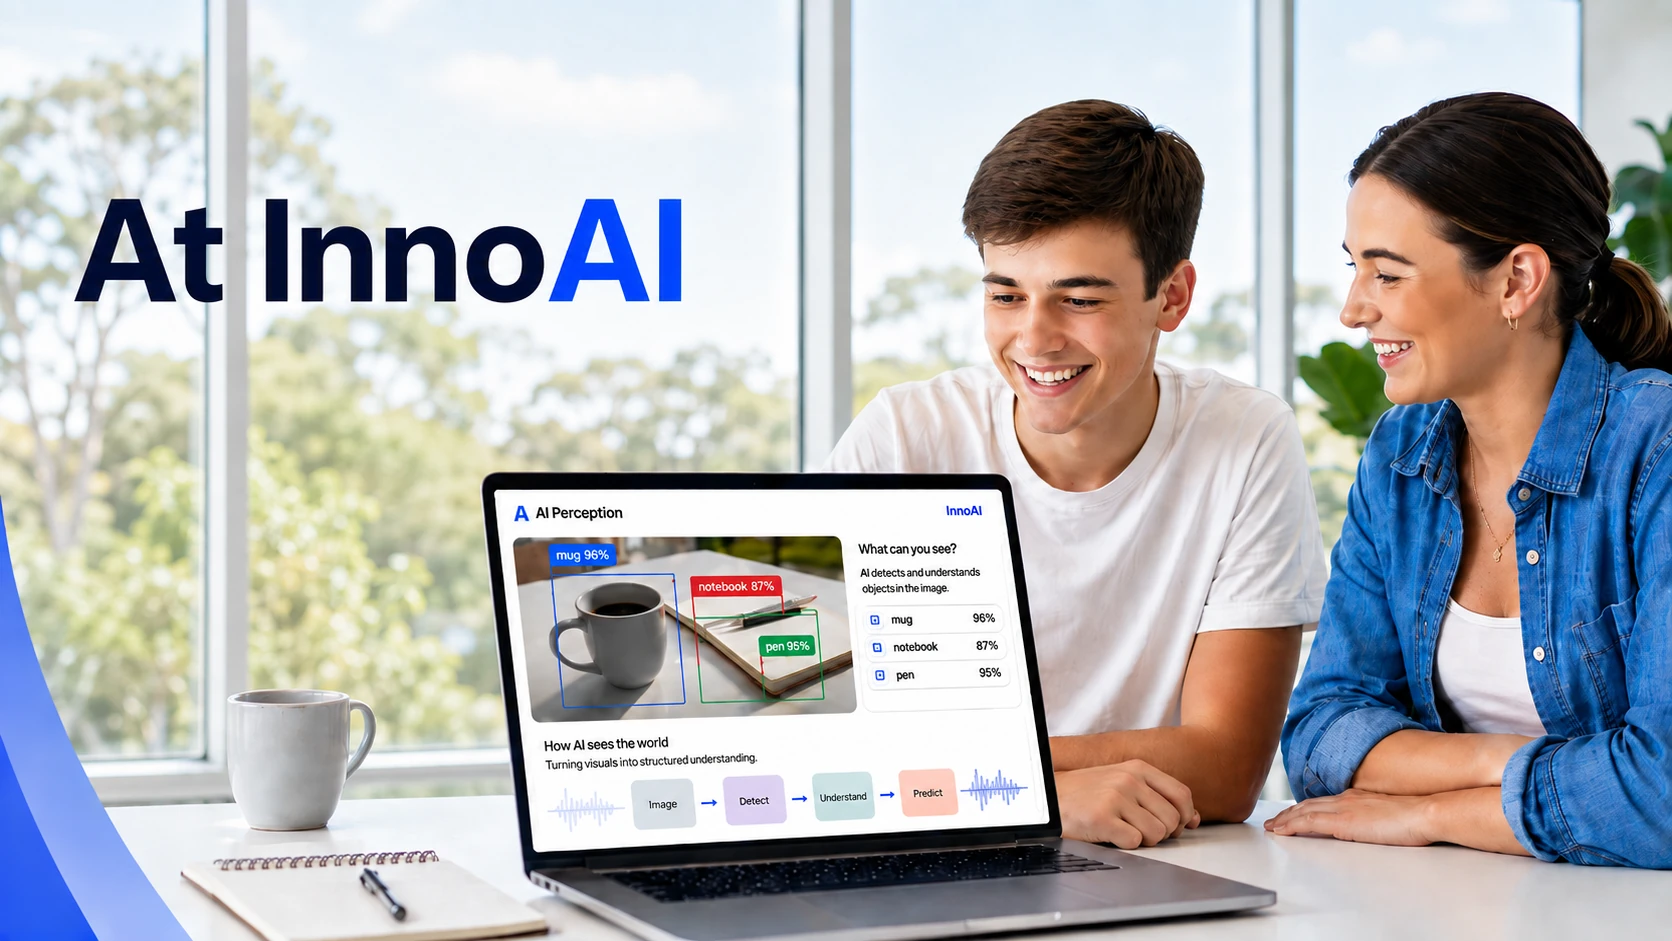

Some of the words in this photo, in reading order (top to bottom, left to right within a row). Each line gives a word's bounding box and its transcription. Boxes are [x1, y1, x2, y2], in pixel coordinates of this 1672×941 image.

[535, 506, 550, 519] AI
[551, 506, 623, 522] Perception
[946, 505, 983, 516] InnoAI
[857, 543, 889, 555] What
[889, 545, 910, 555] can
[910, 545, 931, 557] you
[931, 542, 957, 555] see?
[556, 551, 581, 563] mug
[583, 549, 610, 561] 96%
[860, 568, 870, 578] AI
[870, 568, 906, 578] detects
[906, 567, 924, 578] and
[924, 567, 981, 577] understands
[698, 581, 748, 592] notebook
[751, 580, 775, 592] 87%
[861, 583, 896, 596] objects
[895, 583, 905, 593] in
[904, 583, 920, 593] the
[920, 583, 950, 595] image.
[891, 616, 913, 627] mug
[972, 612, 996, 624] 96%
[765, 643, 785, 654] pen
[893, 641, 939, 652] notebook
[976, 640, 999, 651] 87%
[896, 671, 915, 682] pen
[978, 667, 1002, 678] 95%
[544, 740, 572, 752] How
[573, 739, 586, 751] AI
[587, 740, 615, 751] sees
[615, 737, 636, 750] the
[636, 736, 669, 749] world
[544, 759, 584, 772] Turning
[584, 757, 619, 769] visuals
[619, 756, 639, 768] into
[639, 754, 689, 767] structured
[689, 752, 758, 765] understanding.
[819, 791, 868, 803] Understand
[913, 788, 944, 798] Predict
[648, 800, 678, 811] Image
[739, 796, 770, 806] Detect
